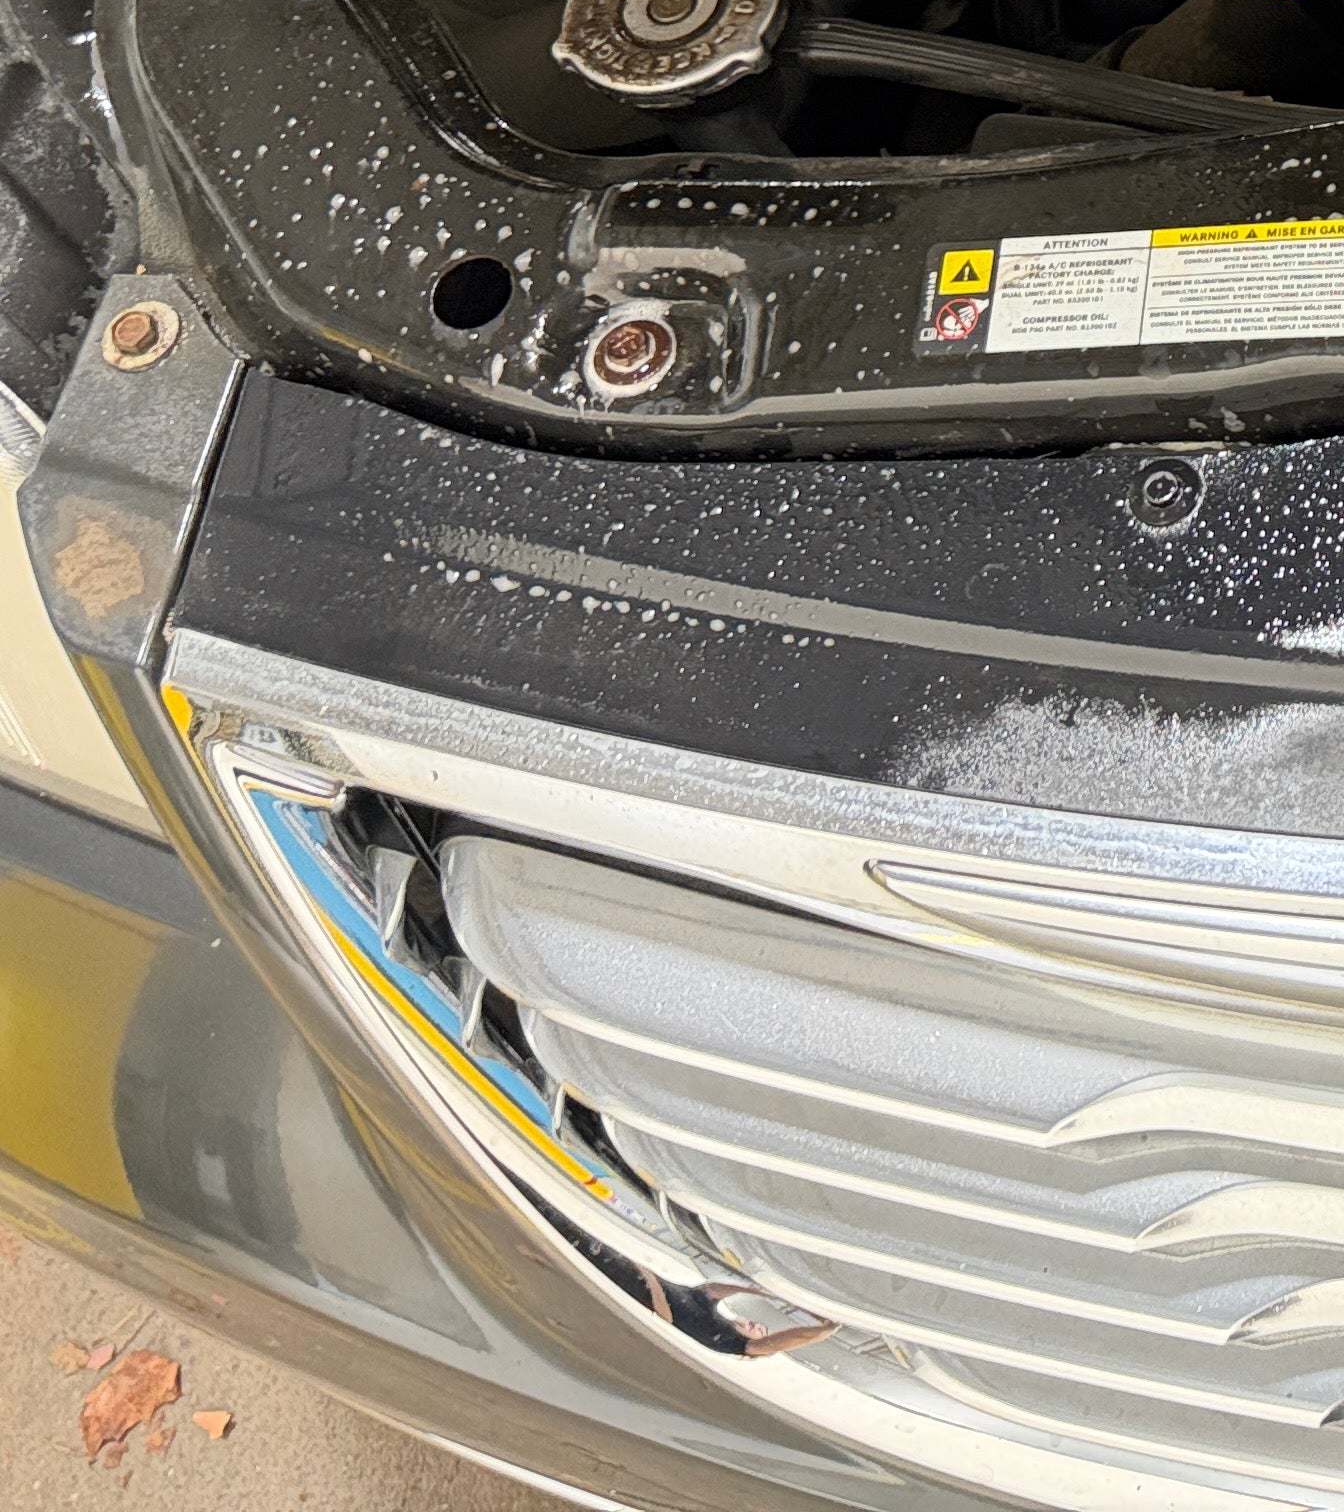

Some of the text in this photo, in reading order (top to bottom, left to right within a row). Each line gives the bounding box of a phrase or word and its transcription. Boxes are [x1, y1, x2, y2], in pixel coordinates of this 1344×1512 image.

[1179, 230, 1238, 242] WARNING
[1266, 227, 1296, 237] MISE
[1300, 226, 1316, 236] EN
[1043, 238, 1108, 249] ATTENTION
[1022, 314, 1087, 324] COMPRESSOR
